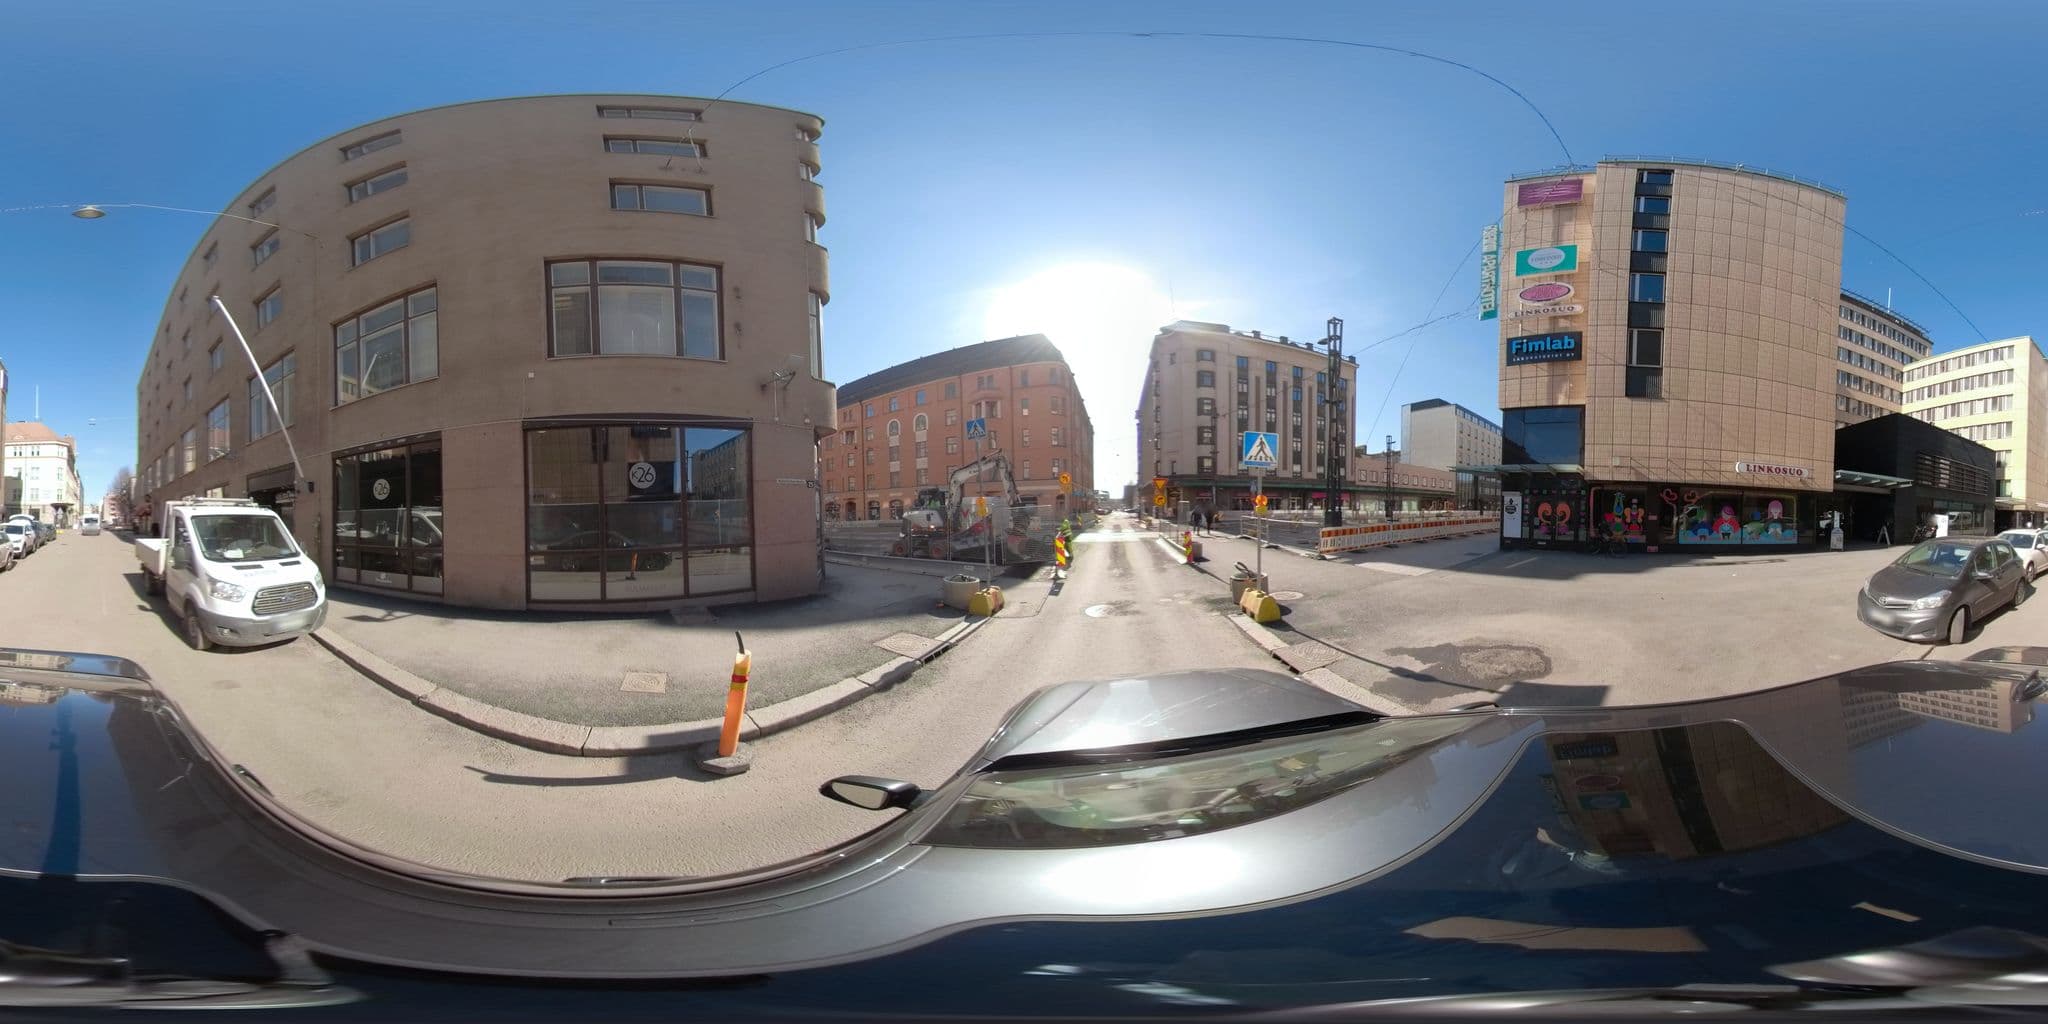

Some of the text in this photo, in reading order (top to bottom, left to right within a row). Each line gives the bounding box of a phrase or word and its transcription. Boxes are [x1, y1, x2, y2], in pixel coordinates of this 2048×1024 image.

[1515, 306, 1574, 317] LINKOSUO
[1512, 335, 1575, 354] Fimlab
[1746, 464, 1803, 476] LINKOSUO
